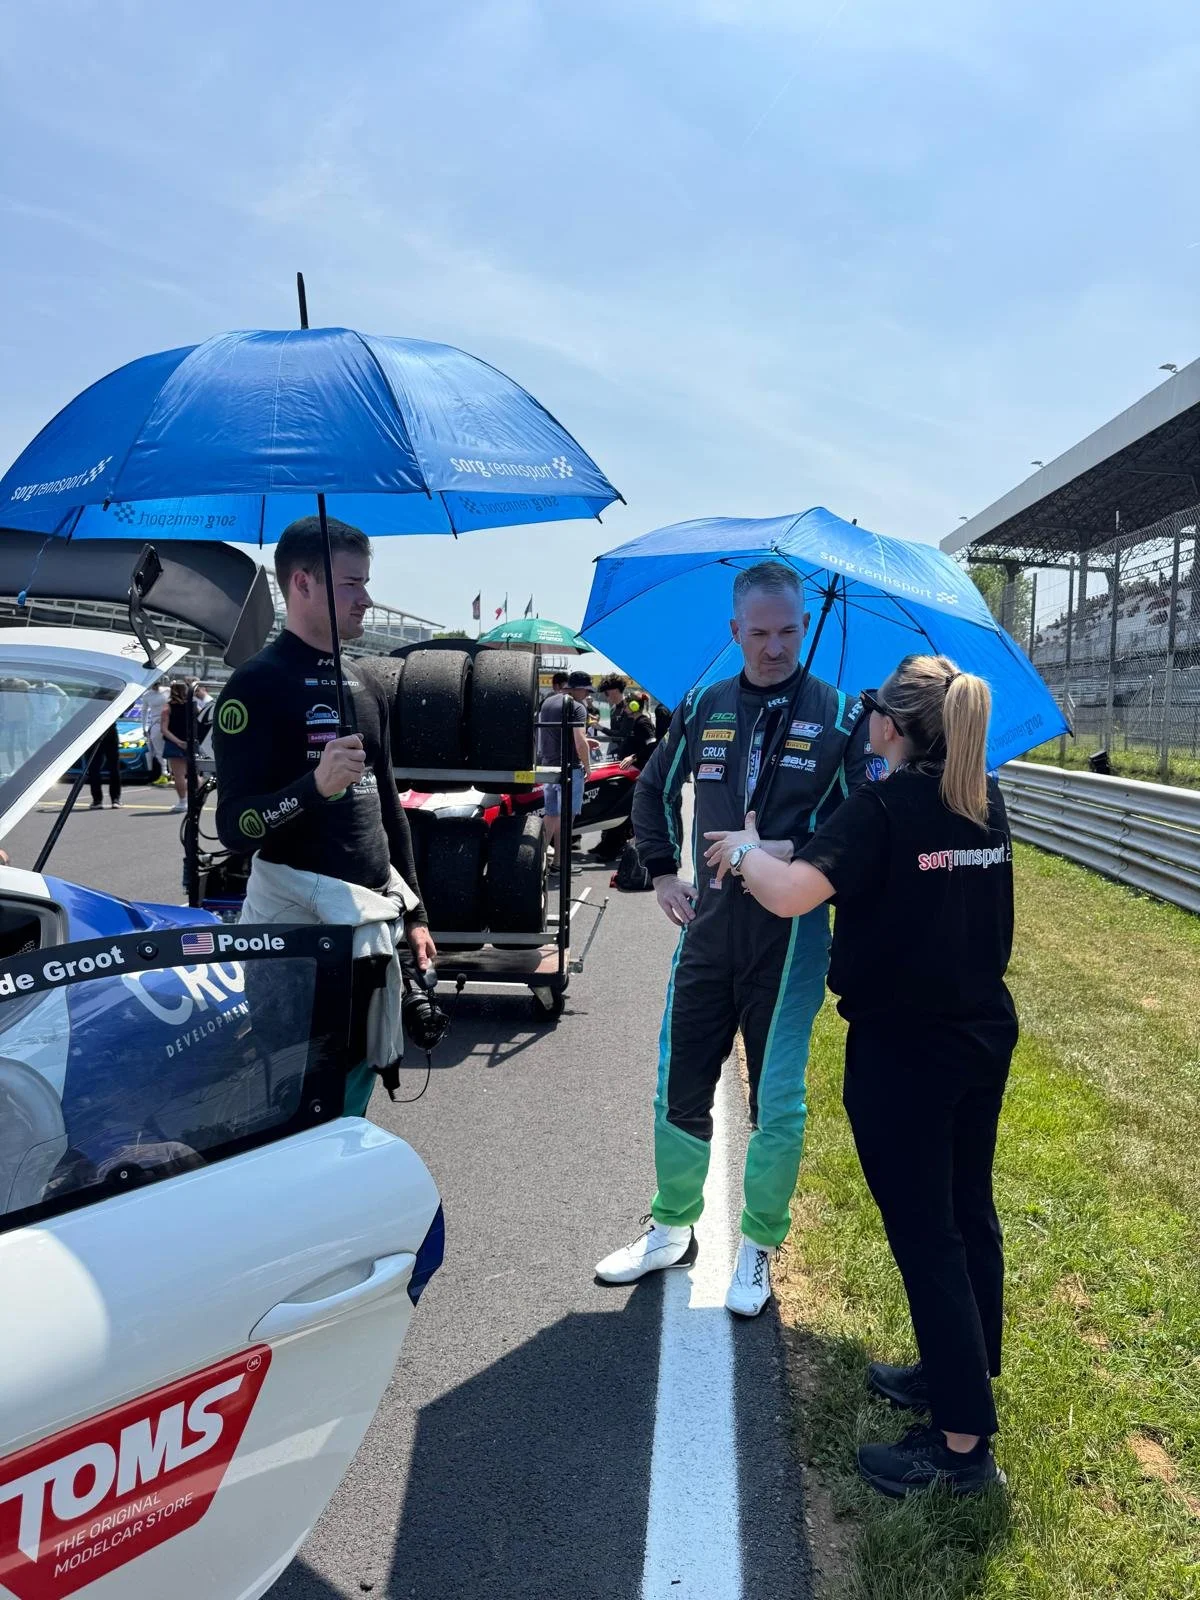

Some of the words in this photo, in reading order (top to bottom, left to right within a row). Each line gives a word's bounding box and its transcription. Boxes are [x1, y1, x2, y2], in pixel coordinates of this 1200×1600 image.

[11, 484, 39, 501] sorg
[34, 469, 88, 497] rennsport
[449, 457, 491, 478] sorg
[488, 461, 557, 480] rennsport
[819, 551, 856, 573] sorg
[858, 567, 932, 599] rennsport
[702, 746, 727, 757] CRUX
[217, 933, 286, 952] Poole
[0, 974, 35, 996] de
[42, 945, 125, 983] Groot
[166, 1000, 250, 1058] DEVELOPMEN
[0, 1373, 245, 1563] TOMS
[54, 1529, 87, 1557] THE
[90, 1491, 161, 1538] ORIGINAL
[54, 1520, 143, 1578] MODELCAR
[146, 1492, 194, 1528] STORE
